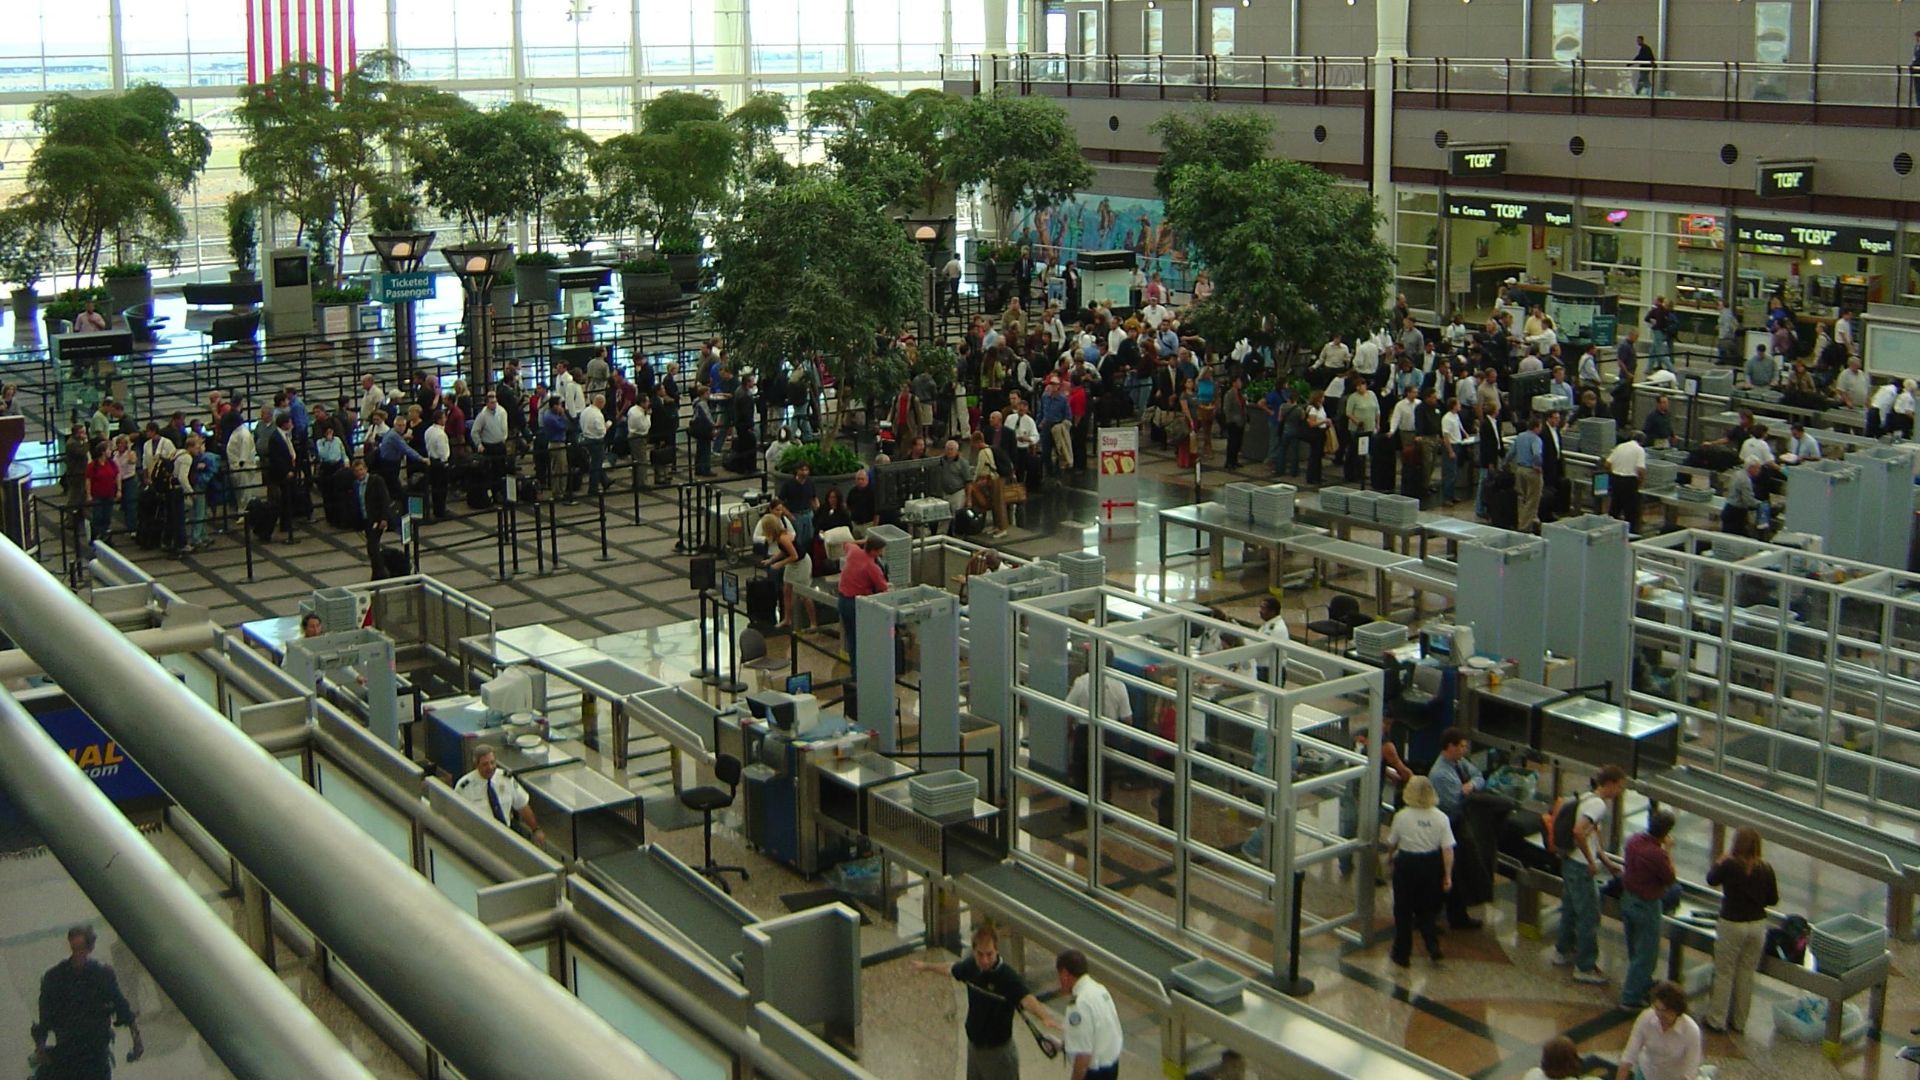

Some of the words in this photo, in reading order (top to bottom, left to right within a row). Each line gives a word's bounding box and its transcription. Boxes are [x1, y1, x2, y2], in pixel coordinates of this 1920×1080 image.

[1462, 205, 1486, 217] Cream
[1545, 212, 1571, 225] Yogurt
[1754, 229, 1785, 242] Cream
[1860, 239, 1891, 253] Yogurt
[391, 276, 429, 288] Ticketed
[385, 287, 434, 299] Passengers
[1102, 435, 1118, 448] Stop
